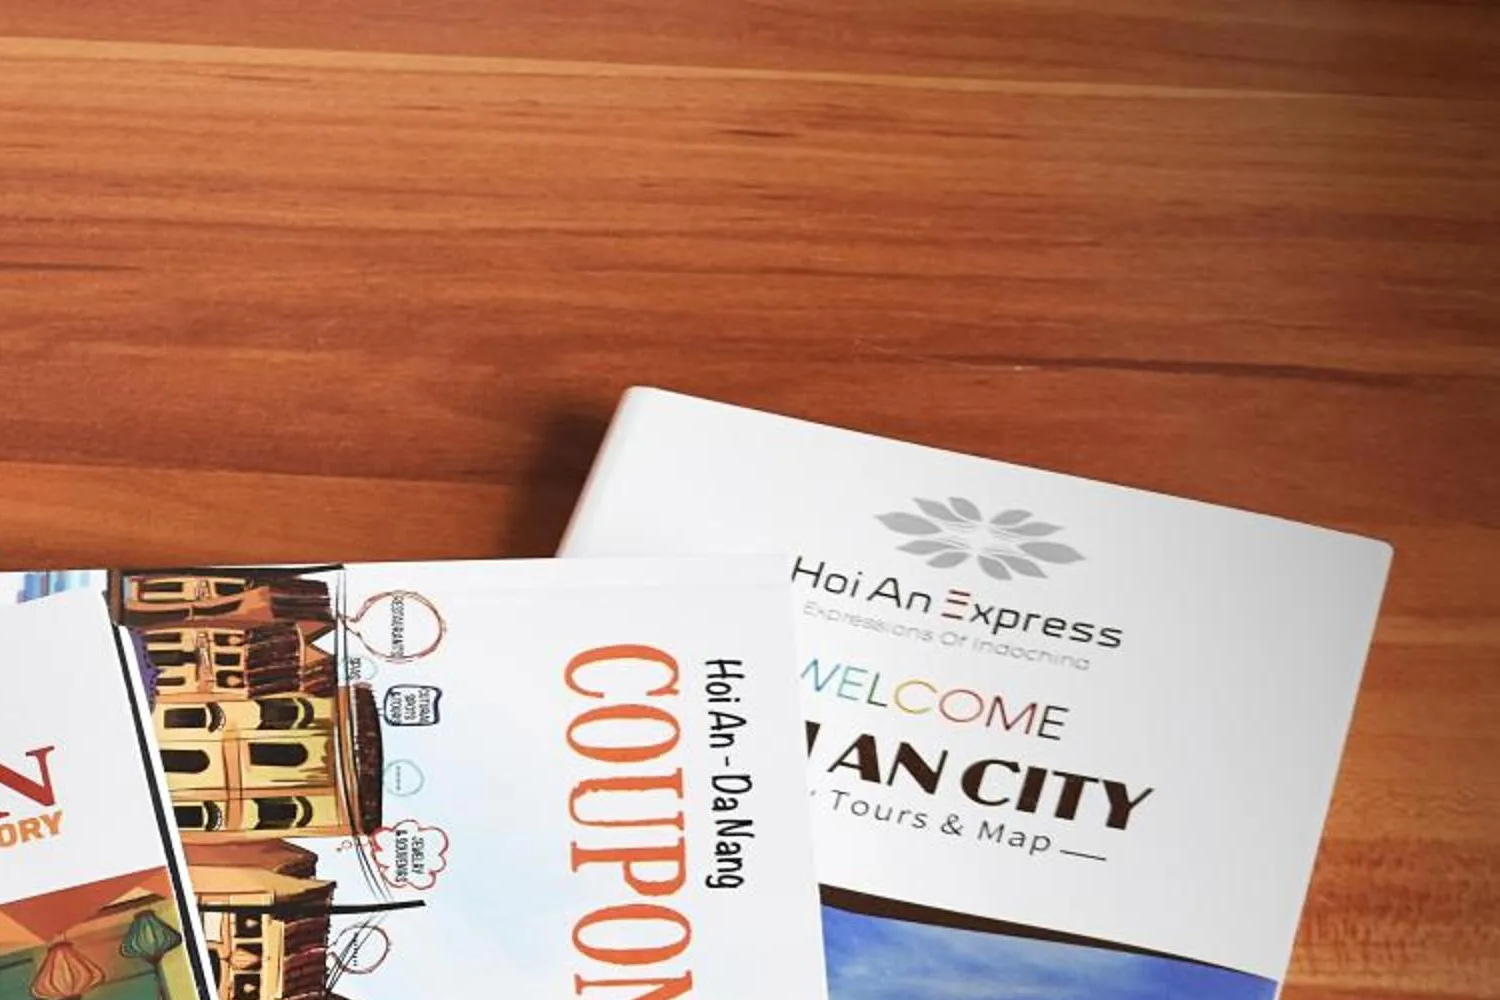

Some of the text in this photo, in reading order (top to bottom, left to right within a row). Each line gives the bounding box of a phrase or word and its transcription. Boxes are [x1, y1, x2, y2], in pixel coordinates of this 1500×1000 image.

[791, 556, 1123, 649] Hoi An Express
[804, 600, 1091, 671] Expressions Of Indochina
[705, 658, 745, 705] Hoi
[708, 710, 747, 749] An
[711, 774, 753, 812] Da
[827, 734, 948, 795] AN
[961, 759, 1154, 831] CITY
[705, 818, 755, 890] Nang
[831, 790, 1051, 855] Tours & Map
